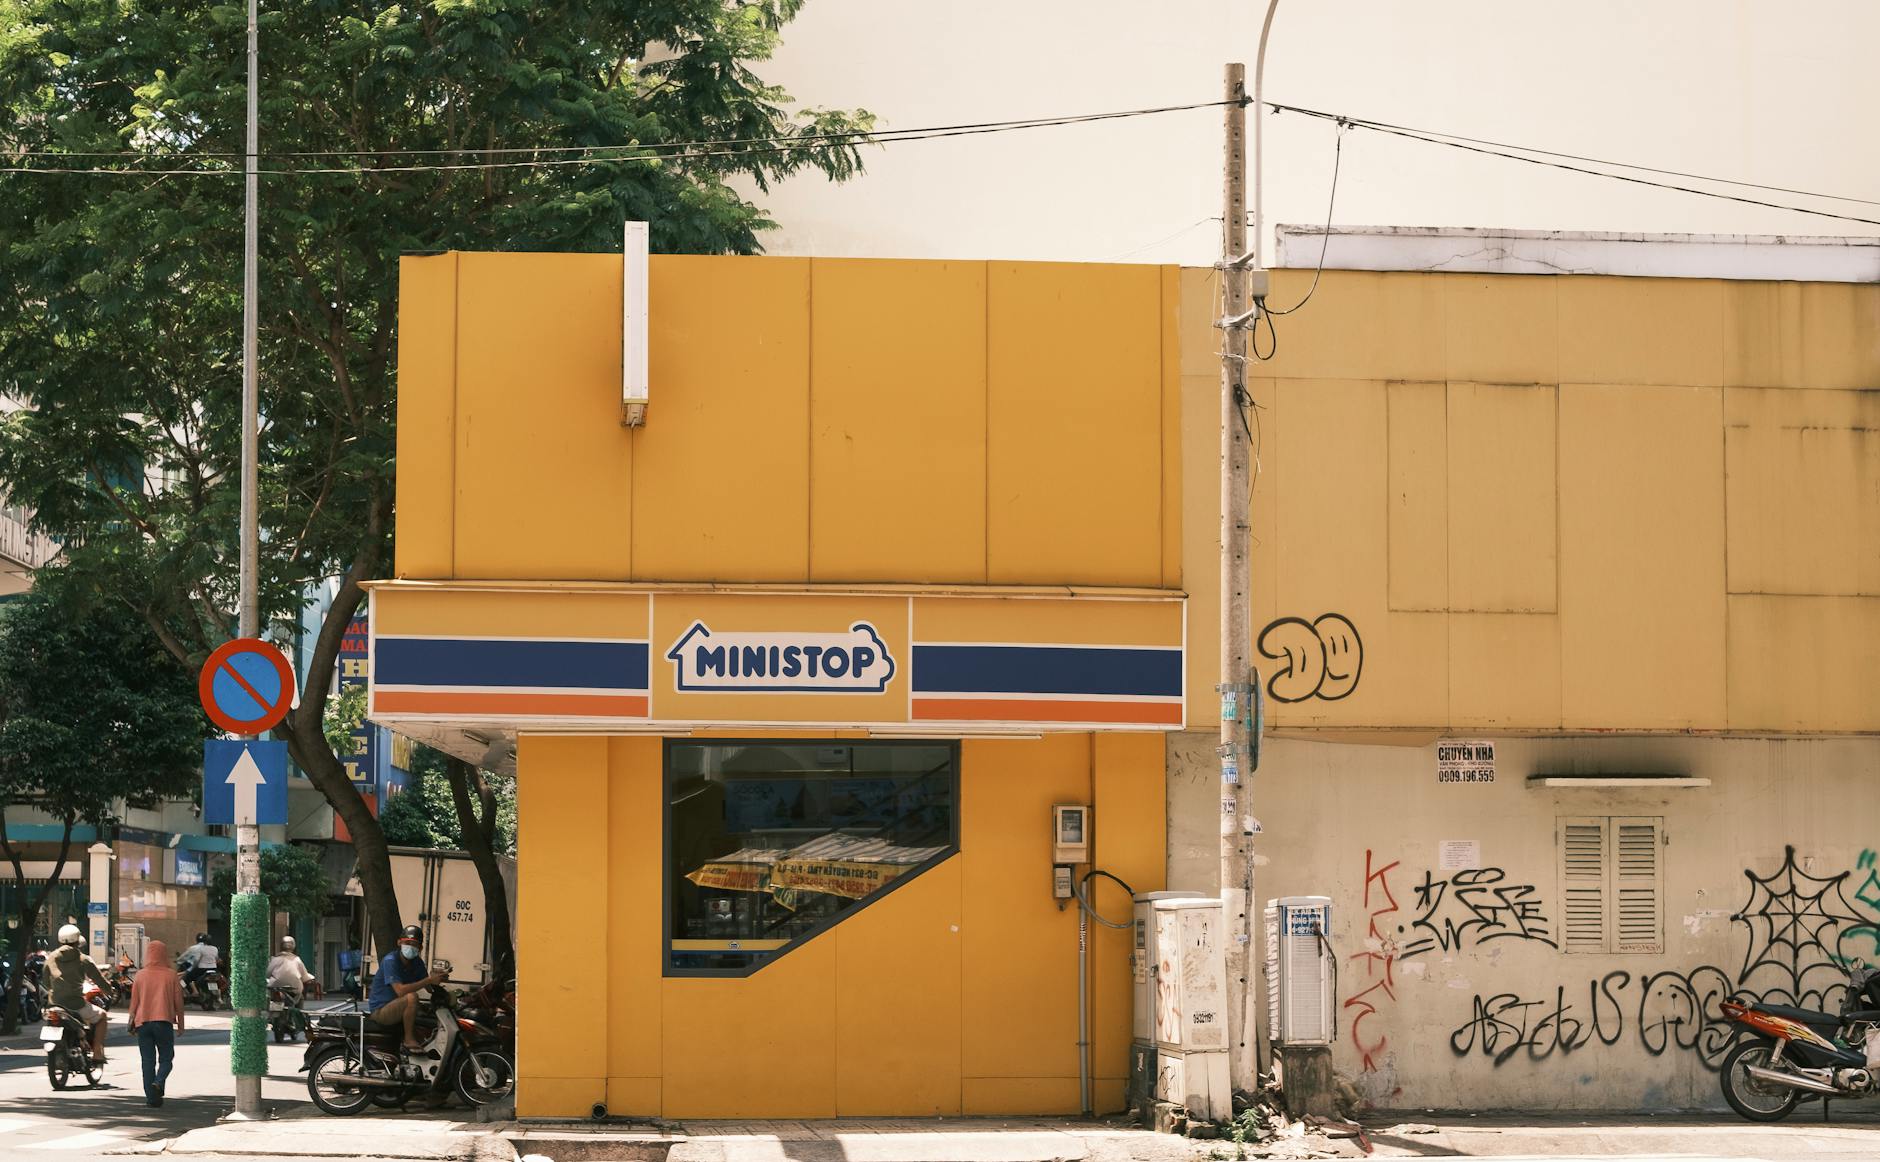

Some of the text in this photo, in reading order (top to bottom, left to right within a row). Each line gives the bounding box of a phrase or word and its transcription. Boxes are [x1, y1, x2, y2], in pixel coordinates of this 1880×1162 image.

[696, 645, 875, 678] MINISTOP
[1438, 770, 1494, 782] 0909.196.559
[455, 900, 471, 910] 60C
[447, 911, 473, 922] 457.74
